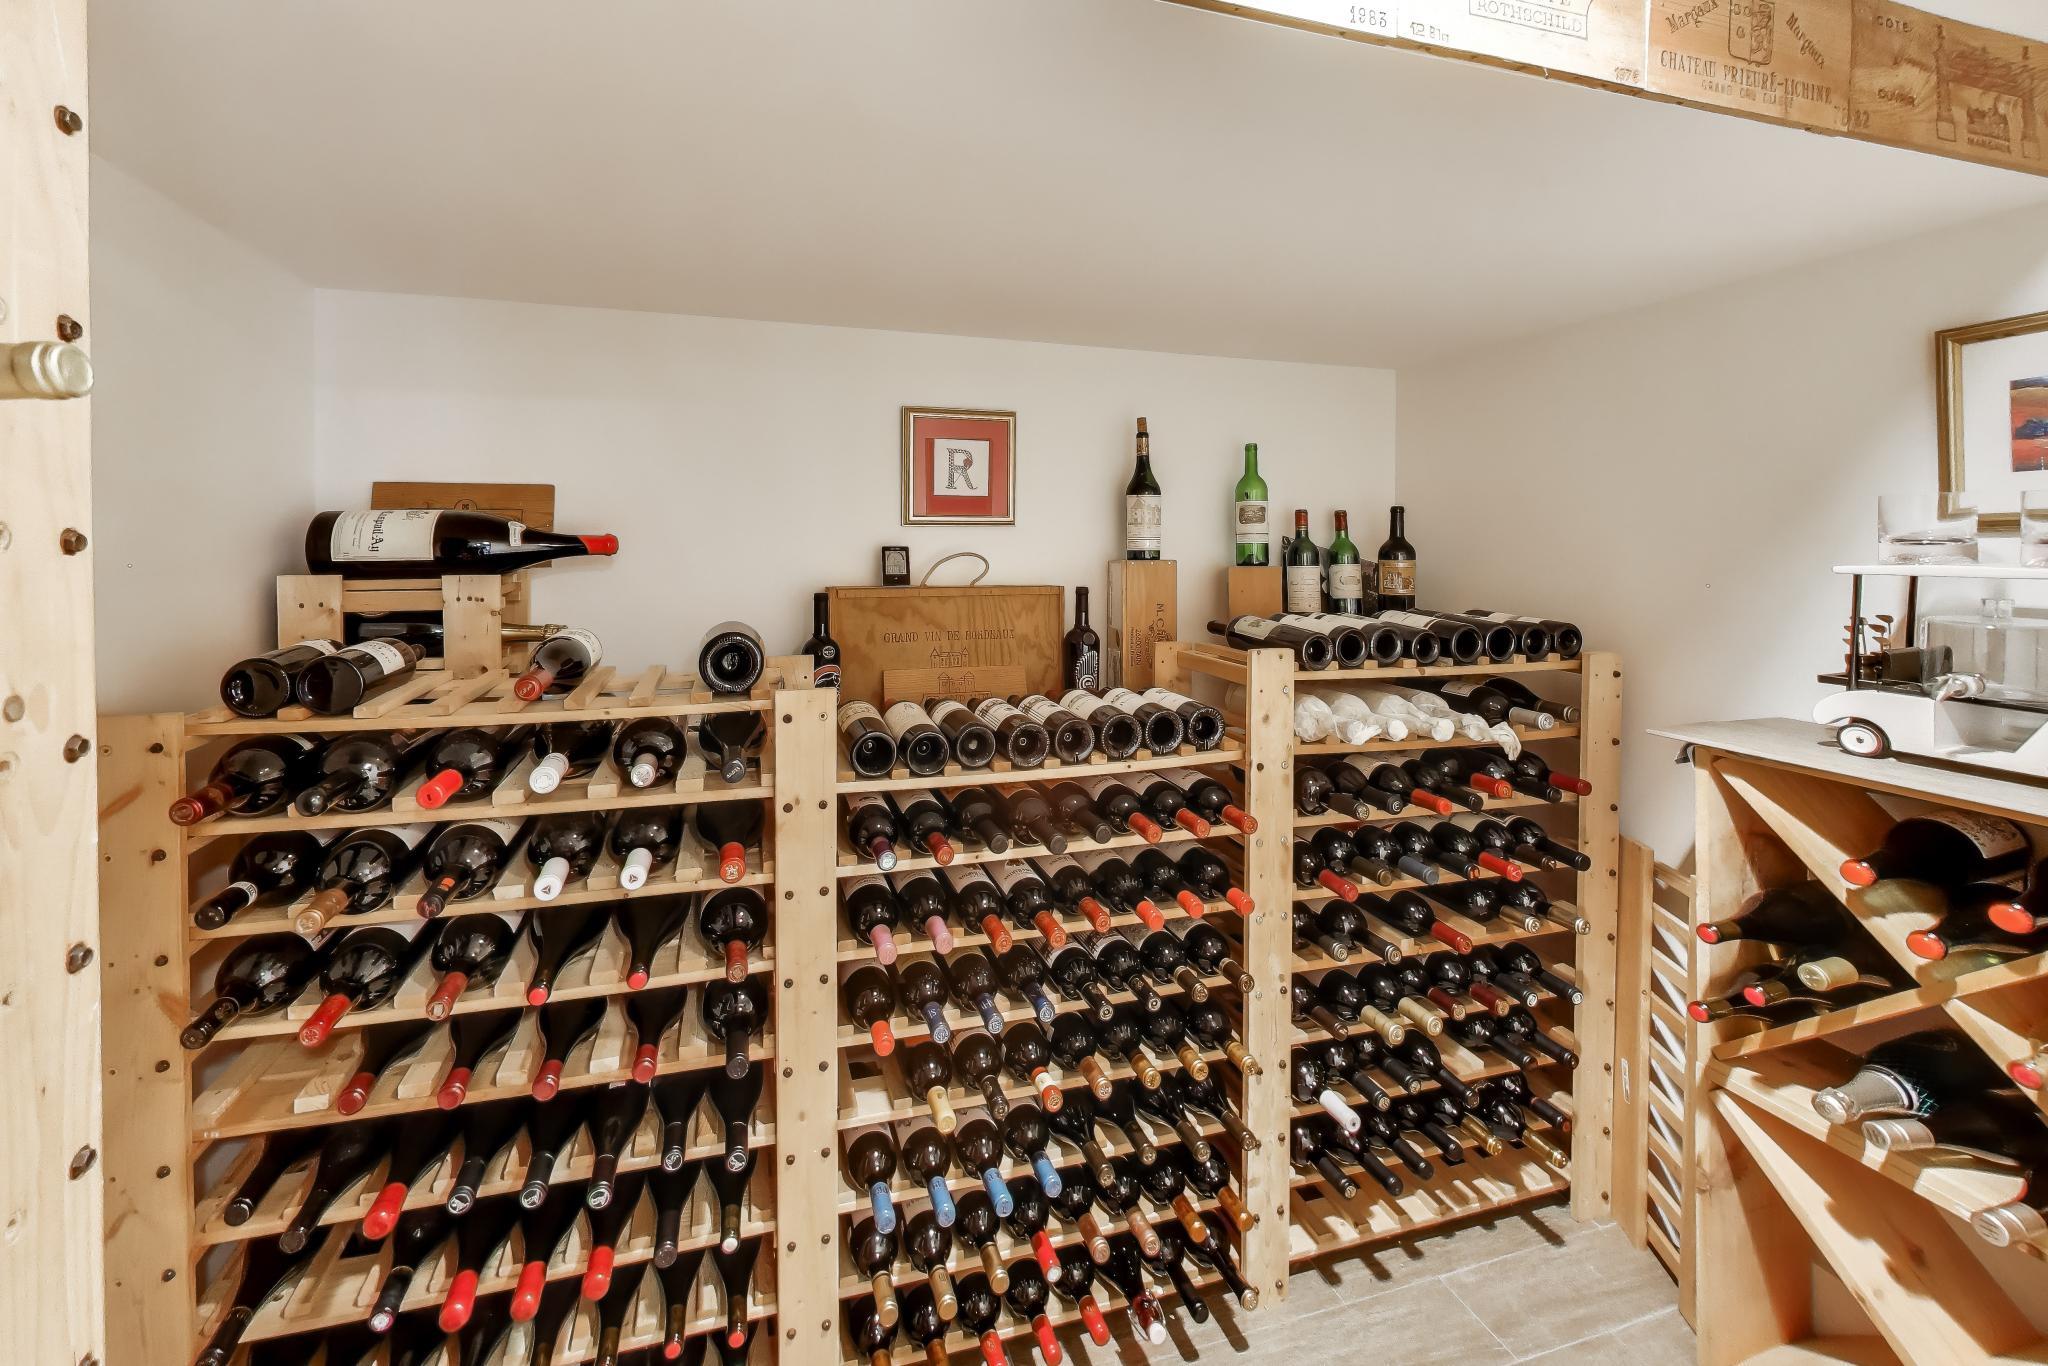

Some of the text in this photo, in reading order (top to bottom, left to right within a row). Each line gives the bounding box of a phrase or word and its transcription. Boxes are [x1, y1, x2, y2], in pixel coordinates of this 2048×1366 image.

[1350, 6, 1387, 28] 1983
[1477, 0, 1583, 33] ROTHSCHILD
[1660, 49, 1717, 79] CHATEAU
[945, 447, 978, 490] R
[883, 628, 1015, 643] GRAND VIN DE BORDEAUX
